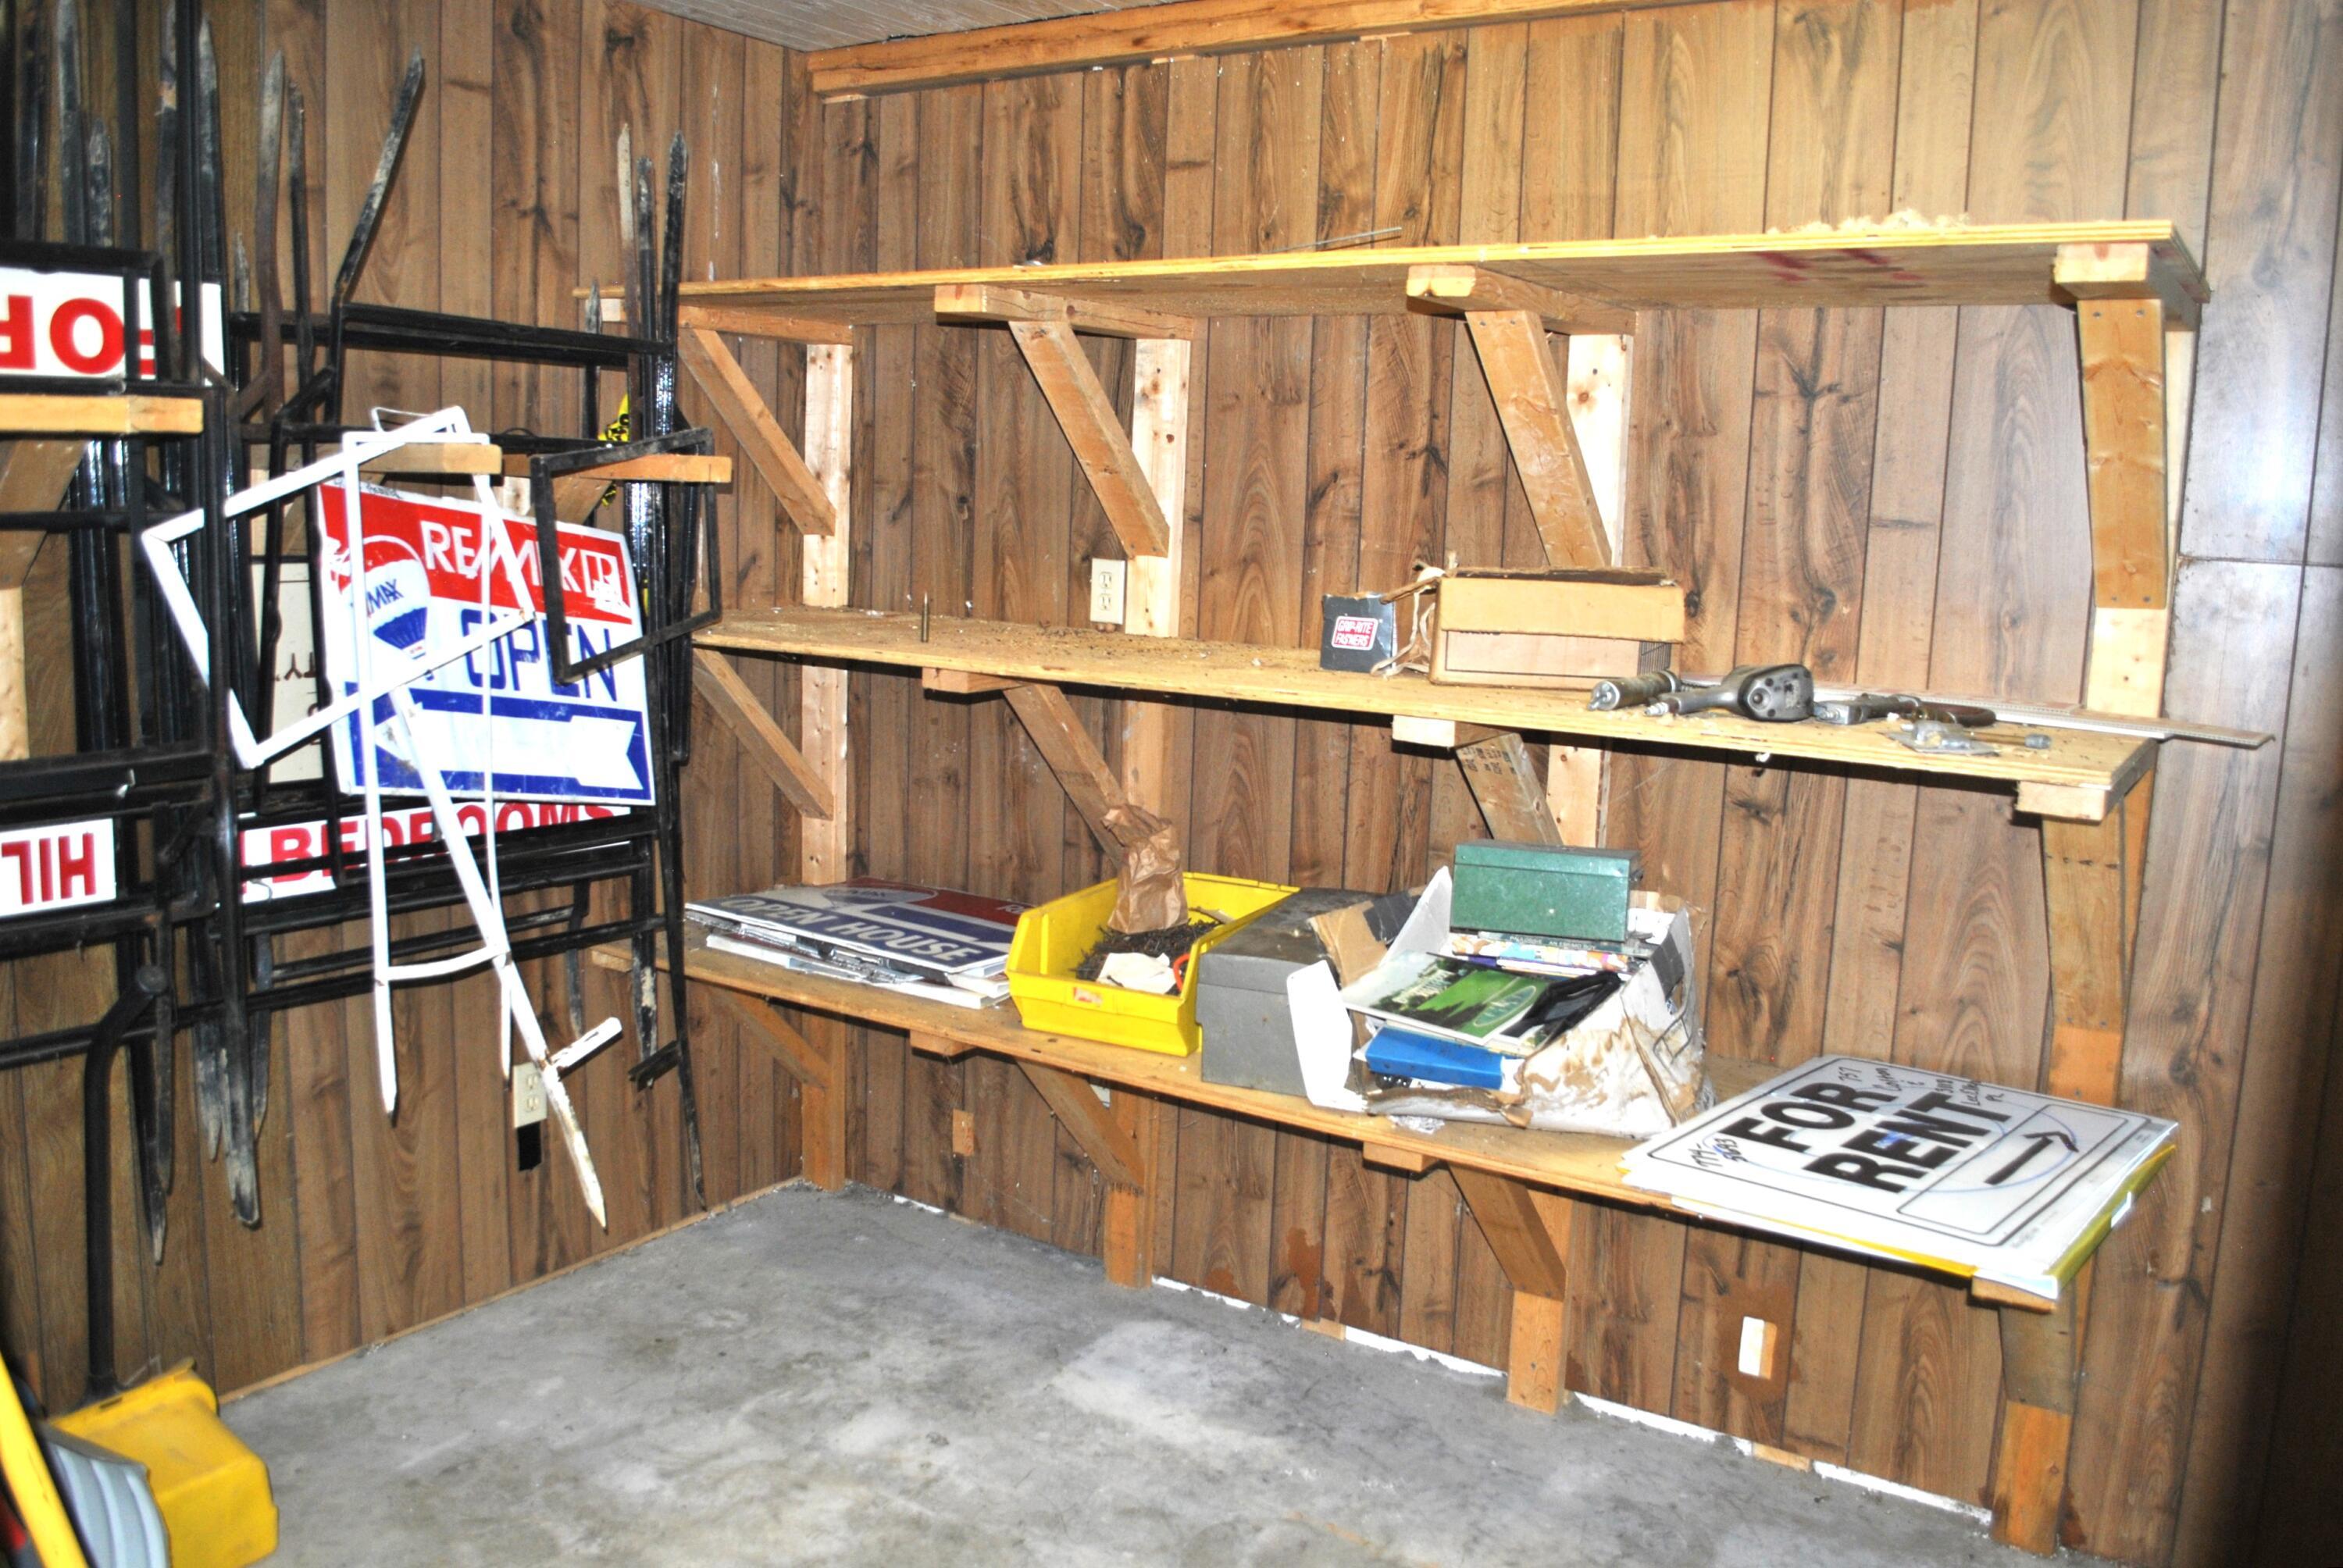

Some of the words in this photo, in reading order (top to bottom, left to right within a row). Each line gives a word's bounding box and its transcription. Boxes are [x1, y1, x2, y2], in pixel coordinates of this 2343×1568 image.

[420, 520, 582, 593] RE/MX
[270, 803, 615, 883] BEOO
[718, 897, 833, 927] OPEN
[826, 921, 982, 961] HOUSE
[1717, 1082, 1897, 1153] FOR
[1803, 1092, 2012, 1193] RENT
